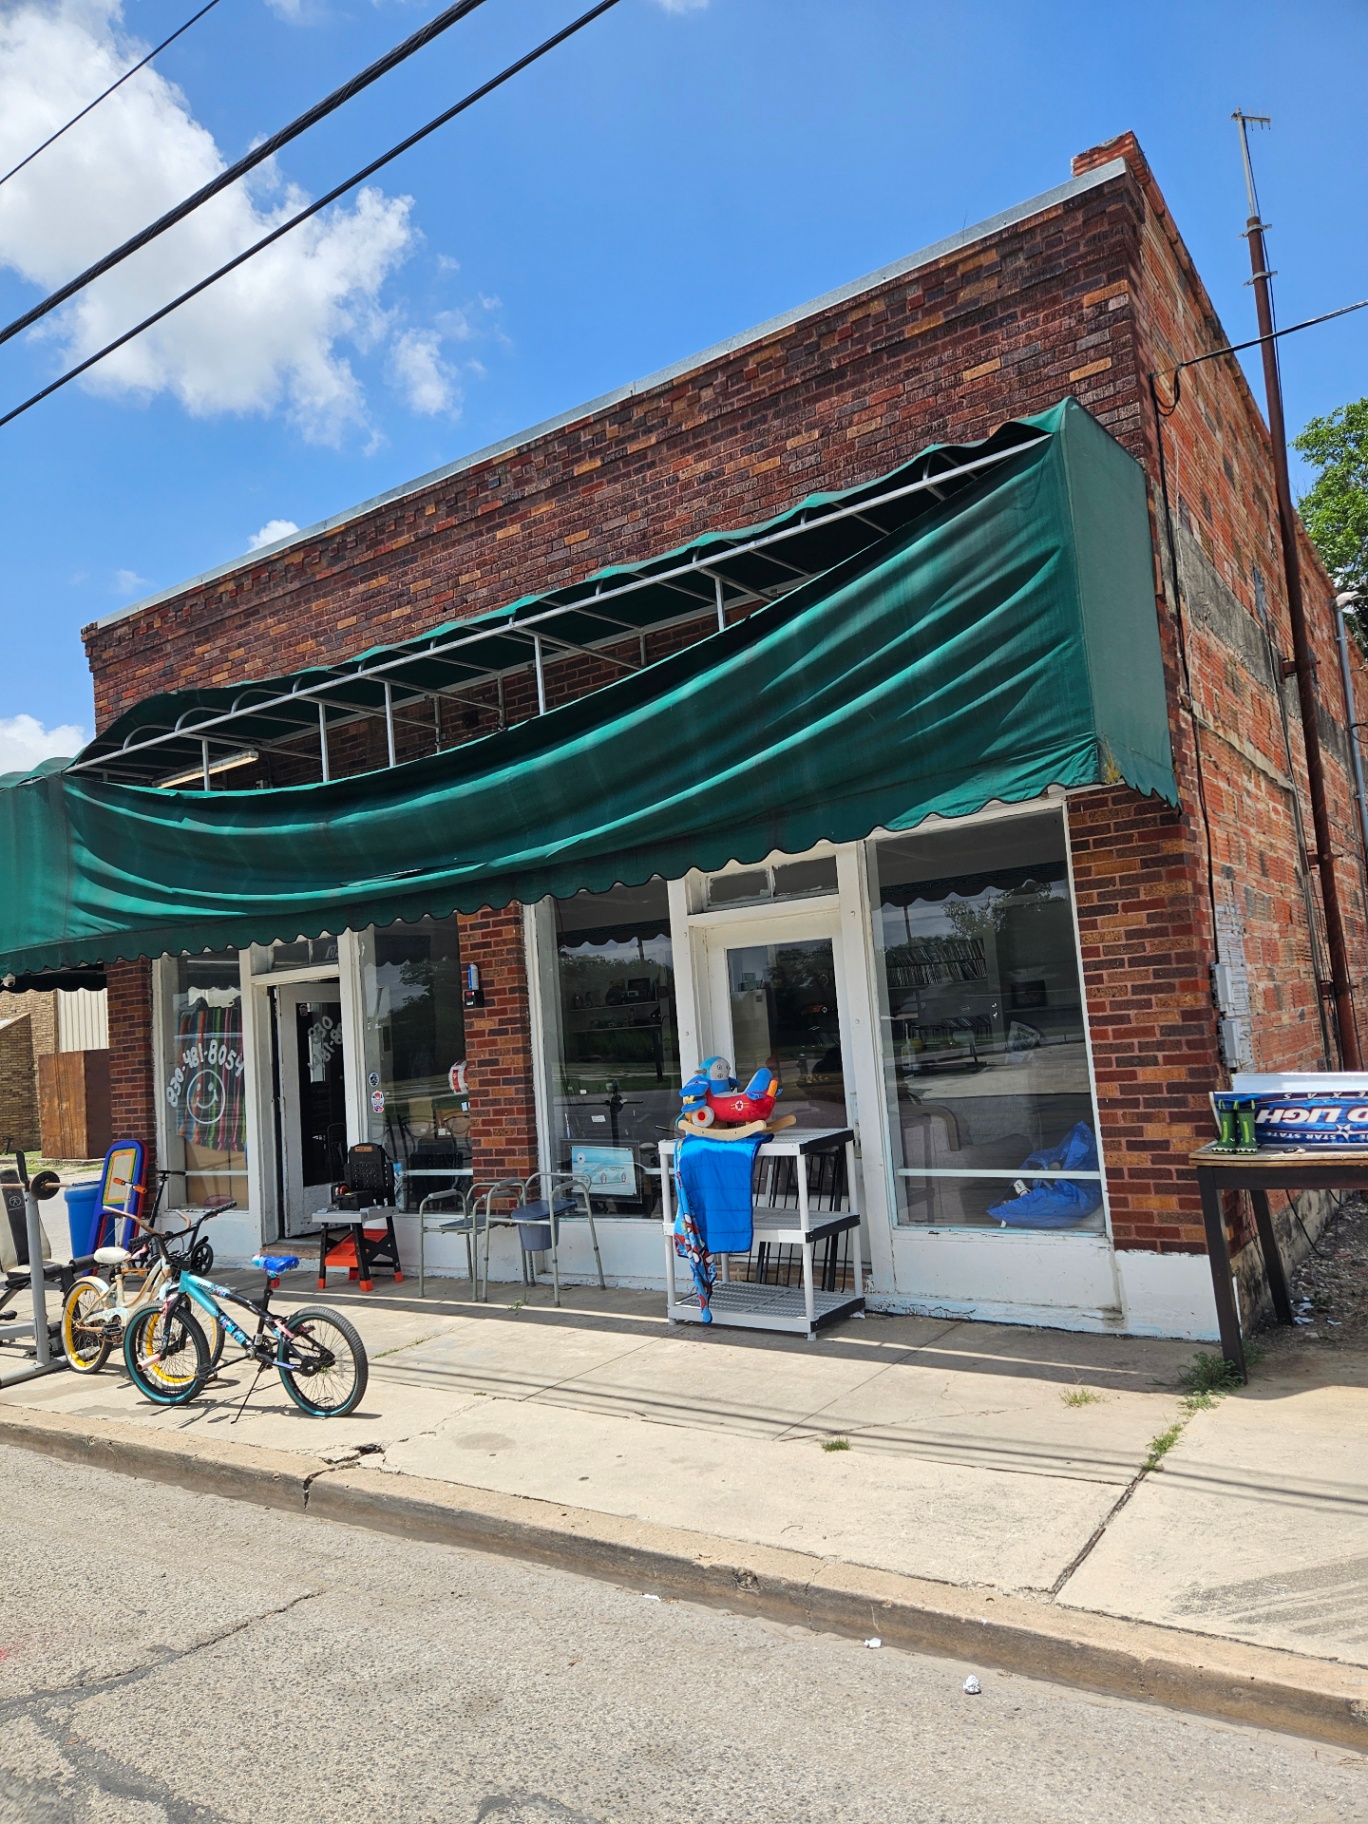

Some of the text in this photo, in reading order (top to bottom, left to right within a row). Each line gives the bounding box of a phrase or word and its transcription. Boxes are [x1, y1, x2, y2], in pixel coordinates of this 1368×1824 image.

[166, 1039, 244, 1107] 830-481-8054
[1255, 1106, 1342, 1124] LIGH
[1266, 1131, 1301, 1140] STATE
